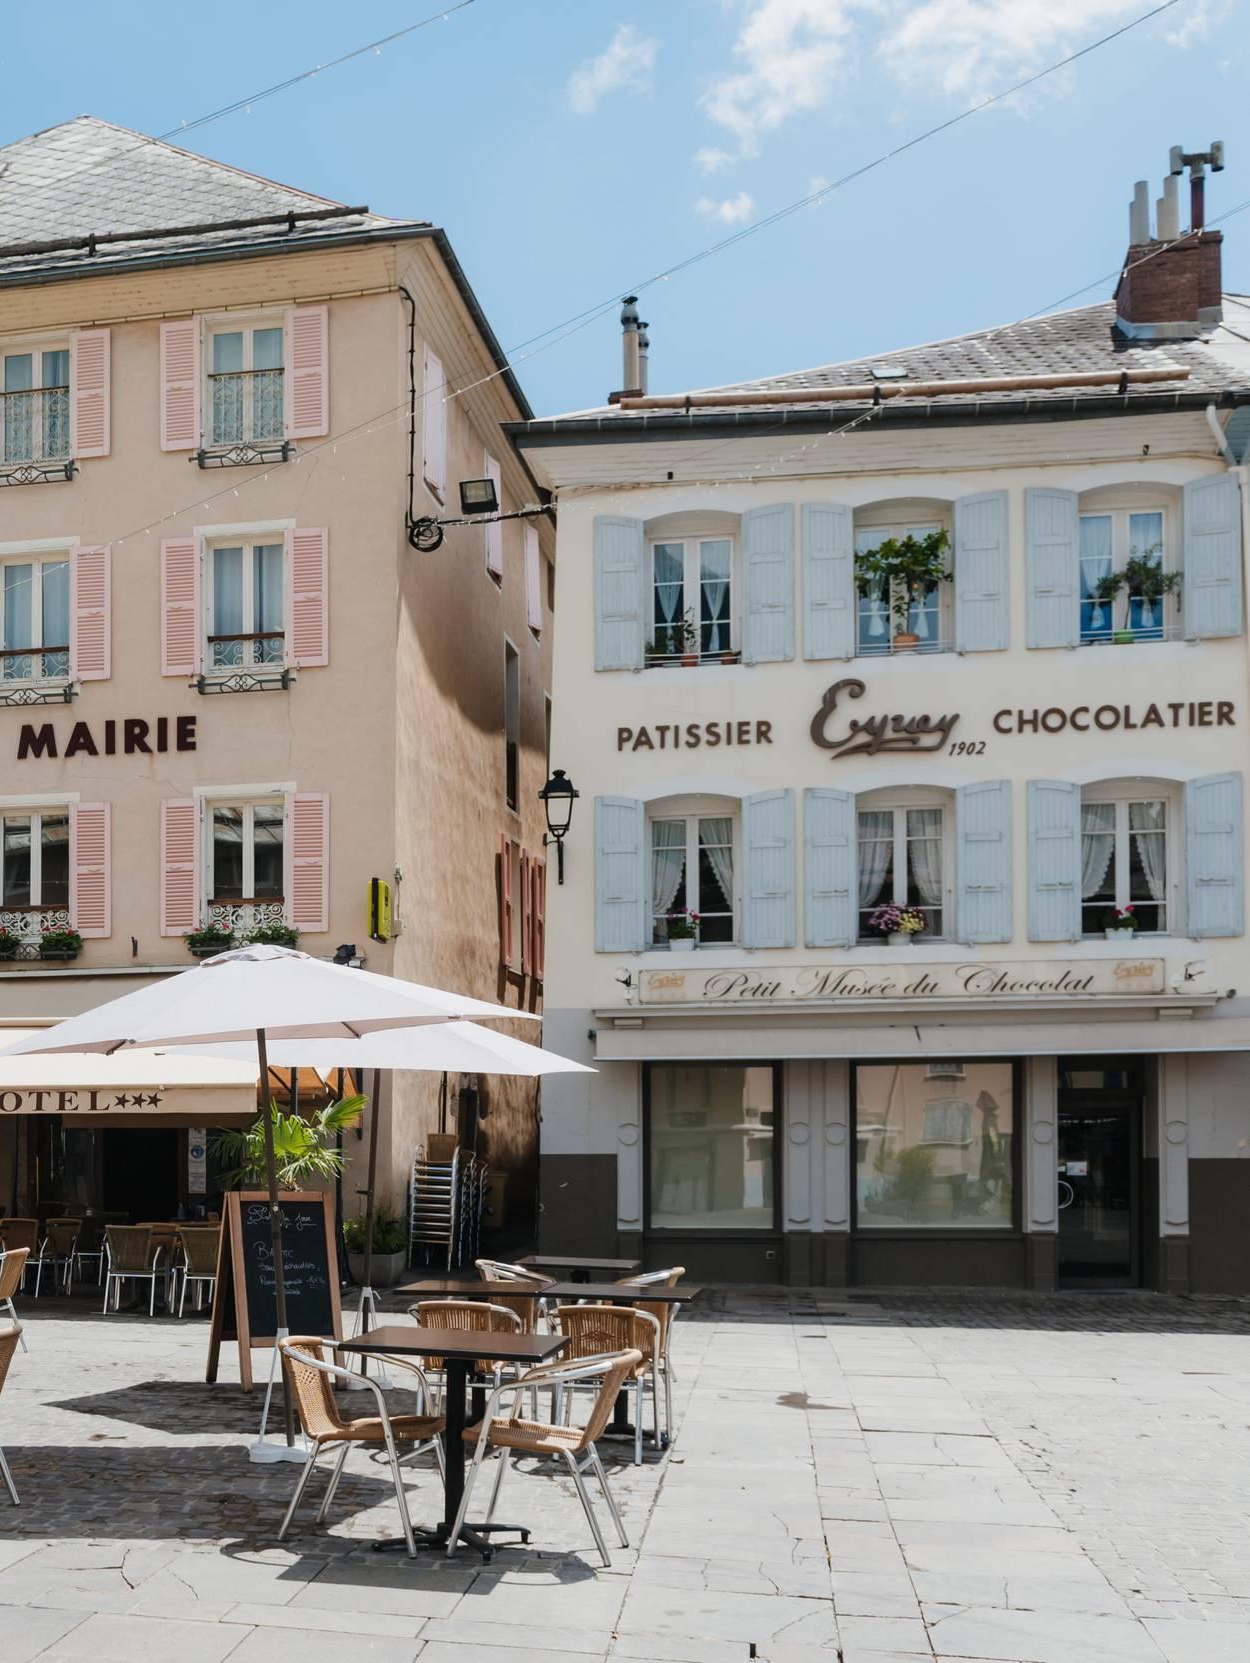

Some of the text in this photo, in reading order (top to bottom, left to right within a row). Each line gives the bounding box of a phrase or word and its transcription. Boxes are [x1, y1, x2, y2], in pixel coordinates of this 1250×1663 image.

[993, 700, 1236, 734] CHOCOLATIER
[16, 715, 198, 760] MAIRIE
[617, 720, 773, 752] PATISSIER
[948, 741, 986, 757] 1902
[702, 964, 1095, 999] Petit Musée du Chocolat
